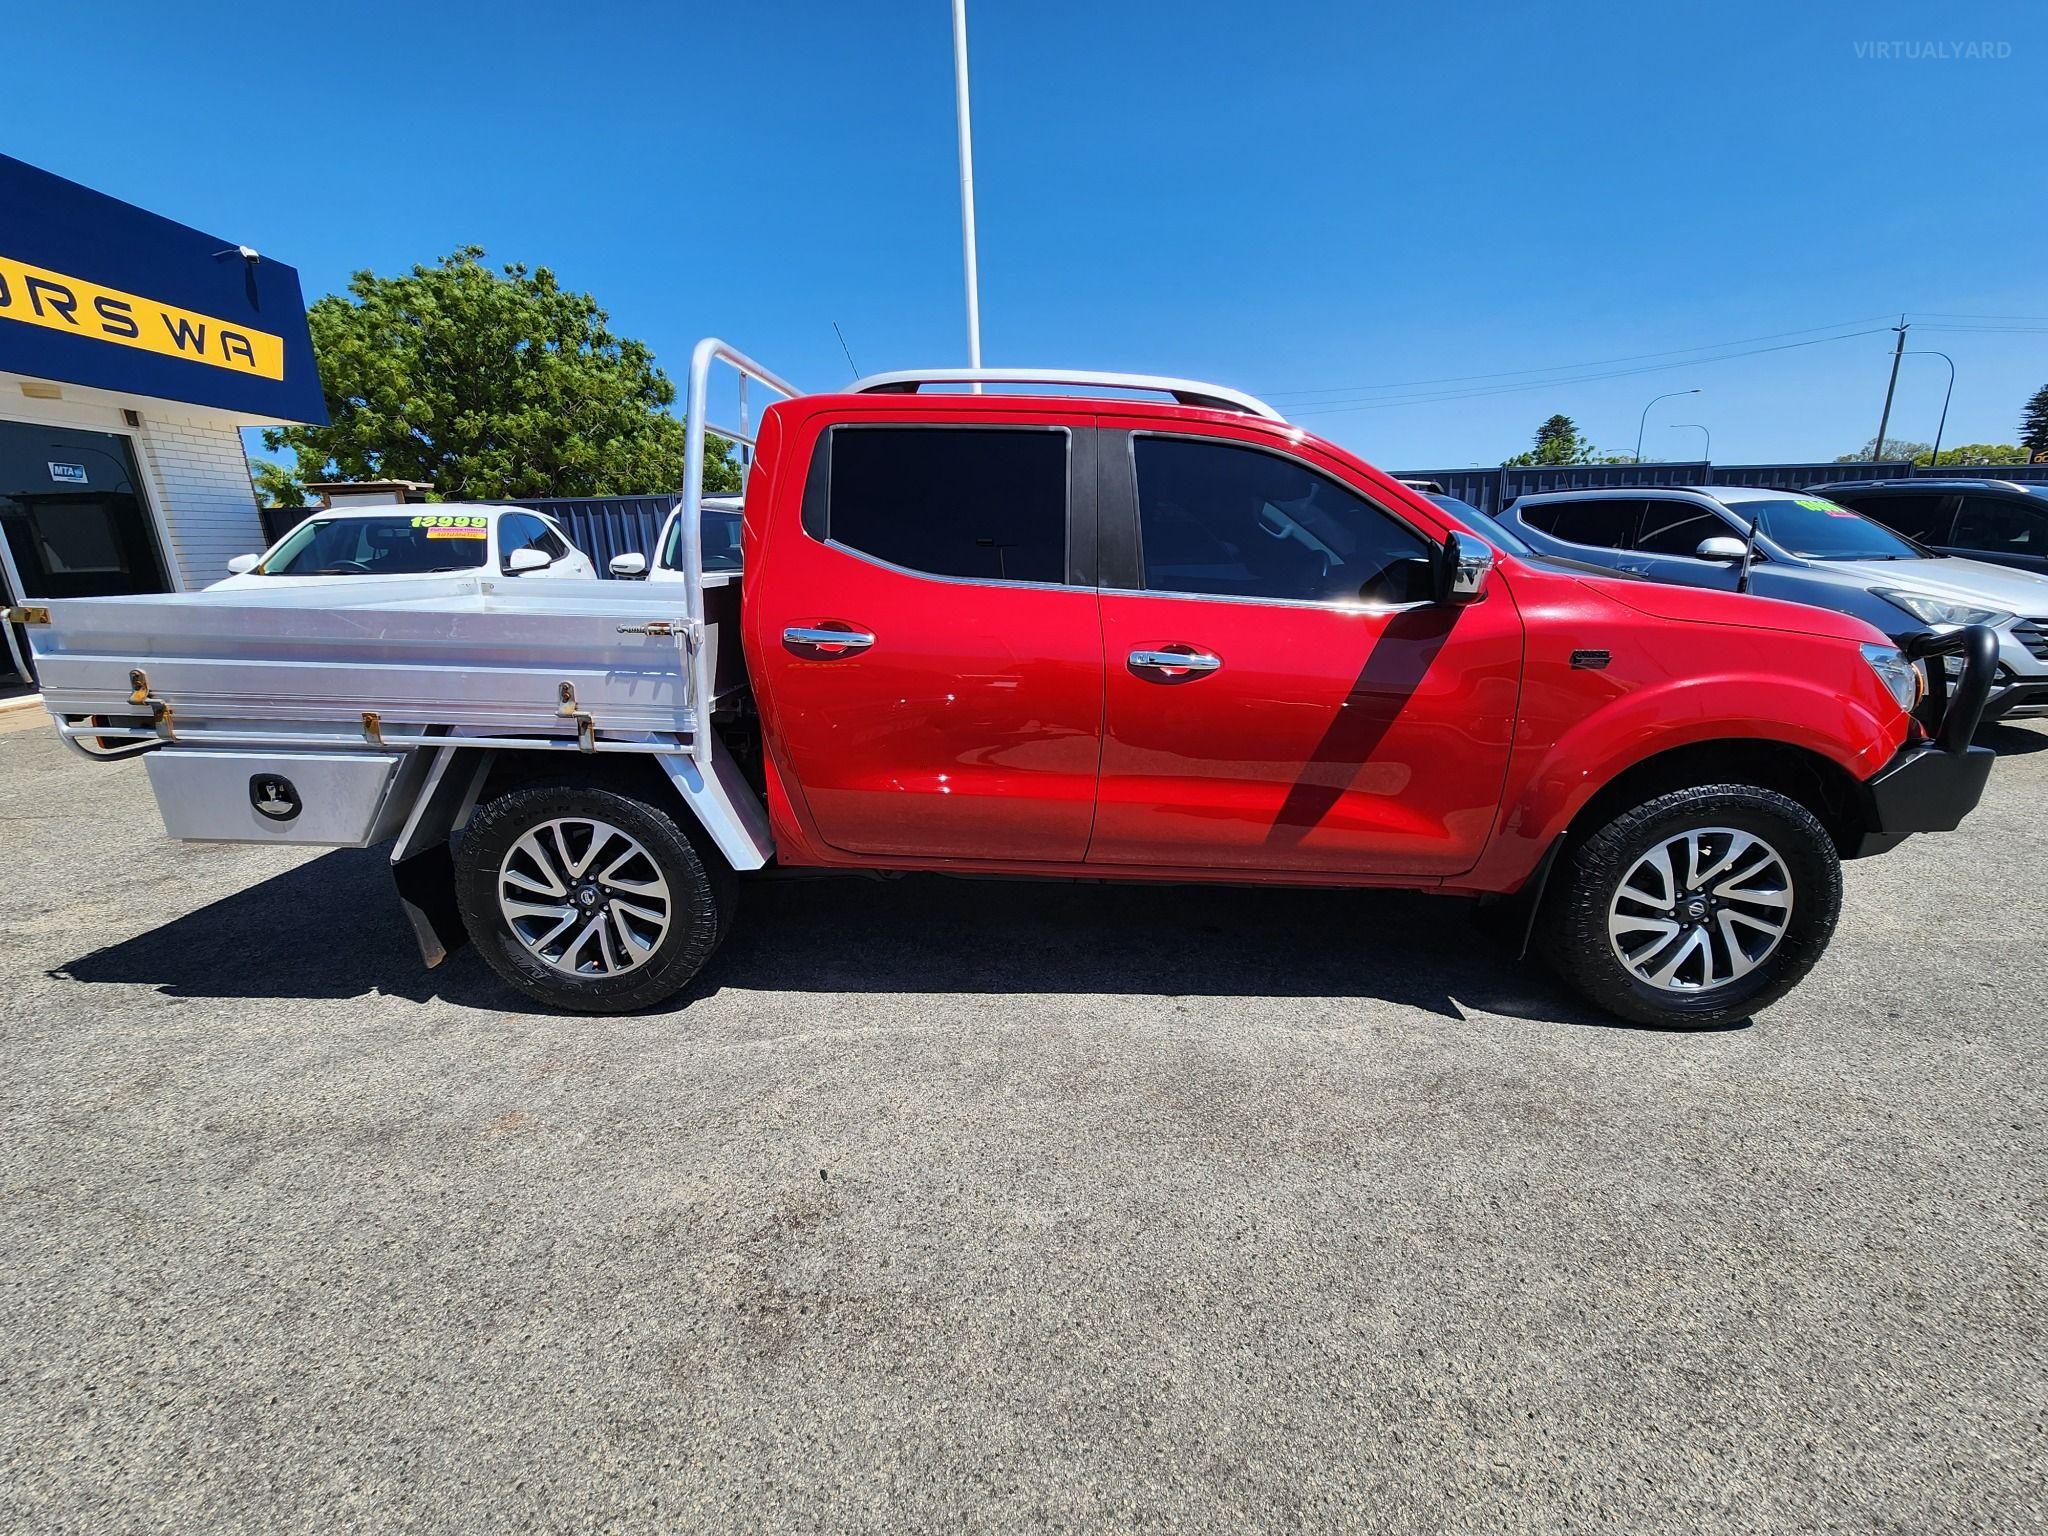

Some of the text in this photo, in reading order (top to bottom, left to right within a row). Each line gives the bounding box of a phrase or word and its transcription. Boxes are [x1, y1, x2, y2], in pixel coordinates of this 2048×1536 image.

[160, 312, 257, 368] WA
[54, 465, 75, 476] MTA
[411, 516, 487, 528] 13999
